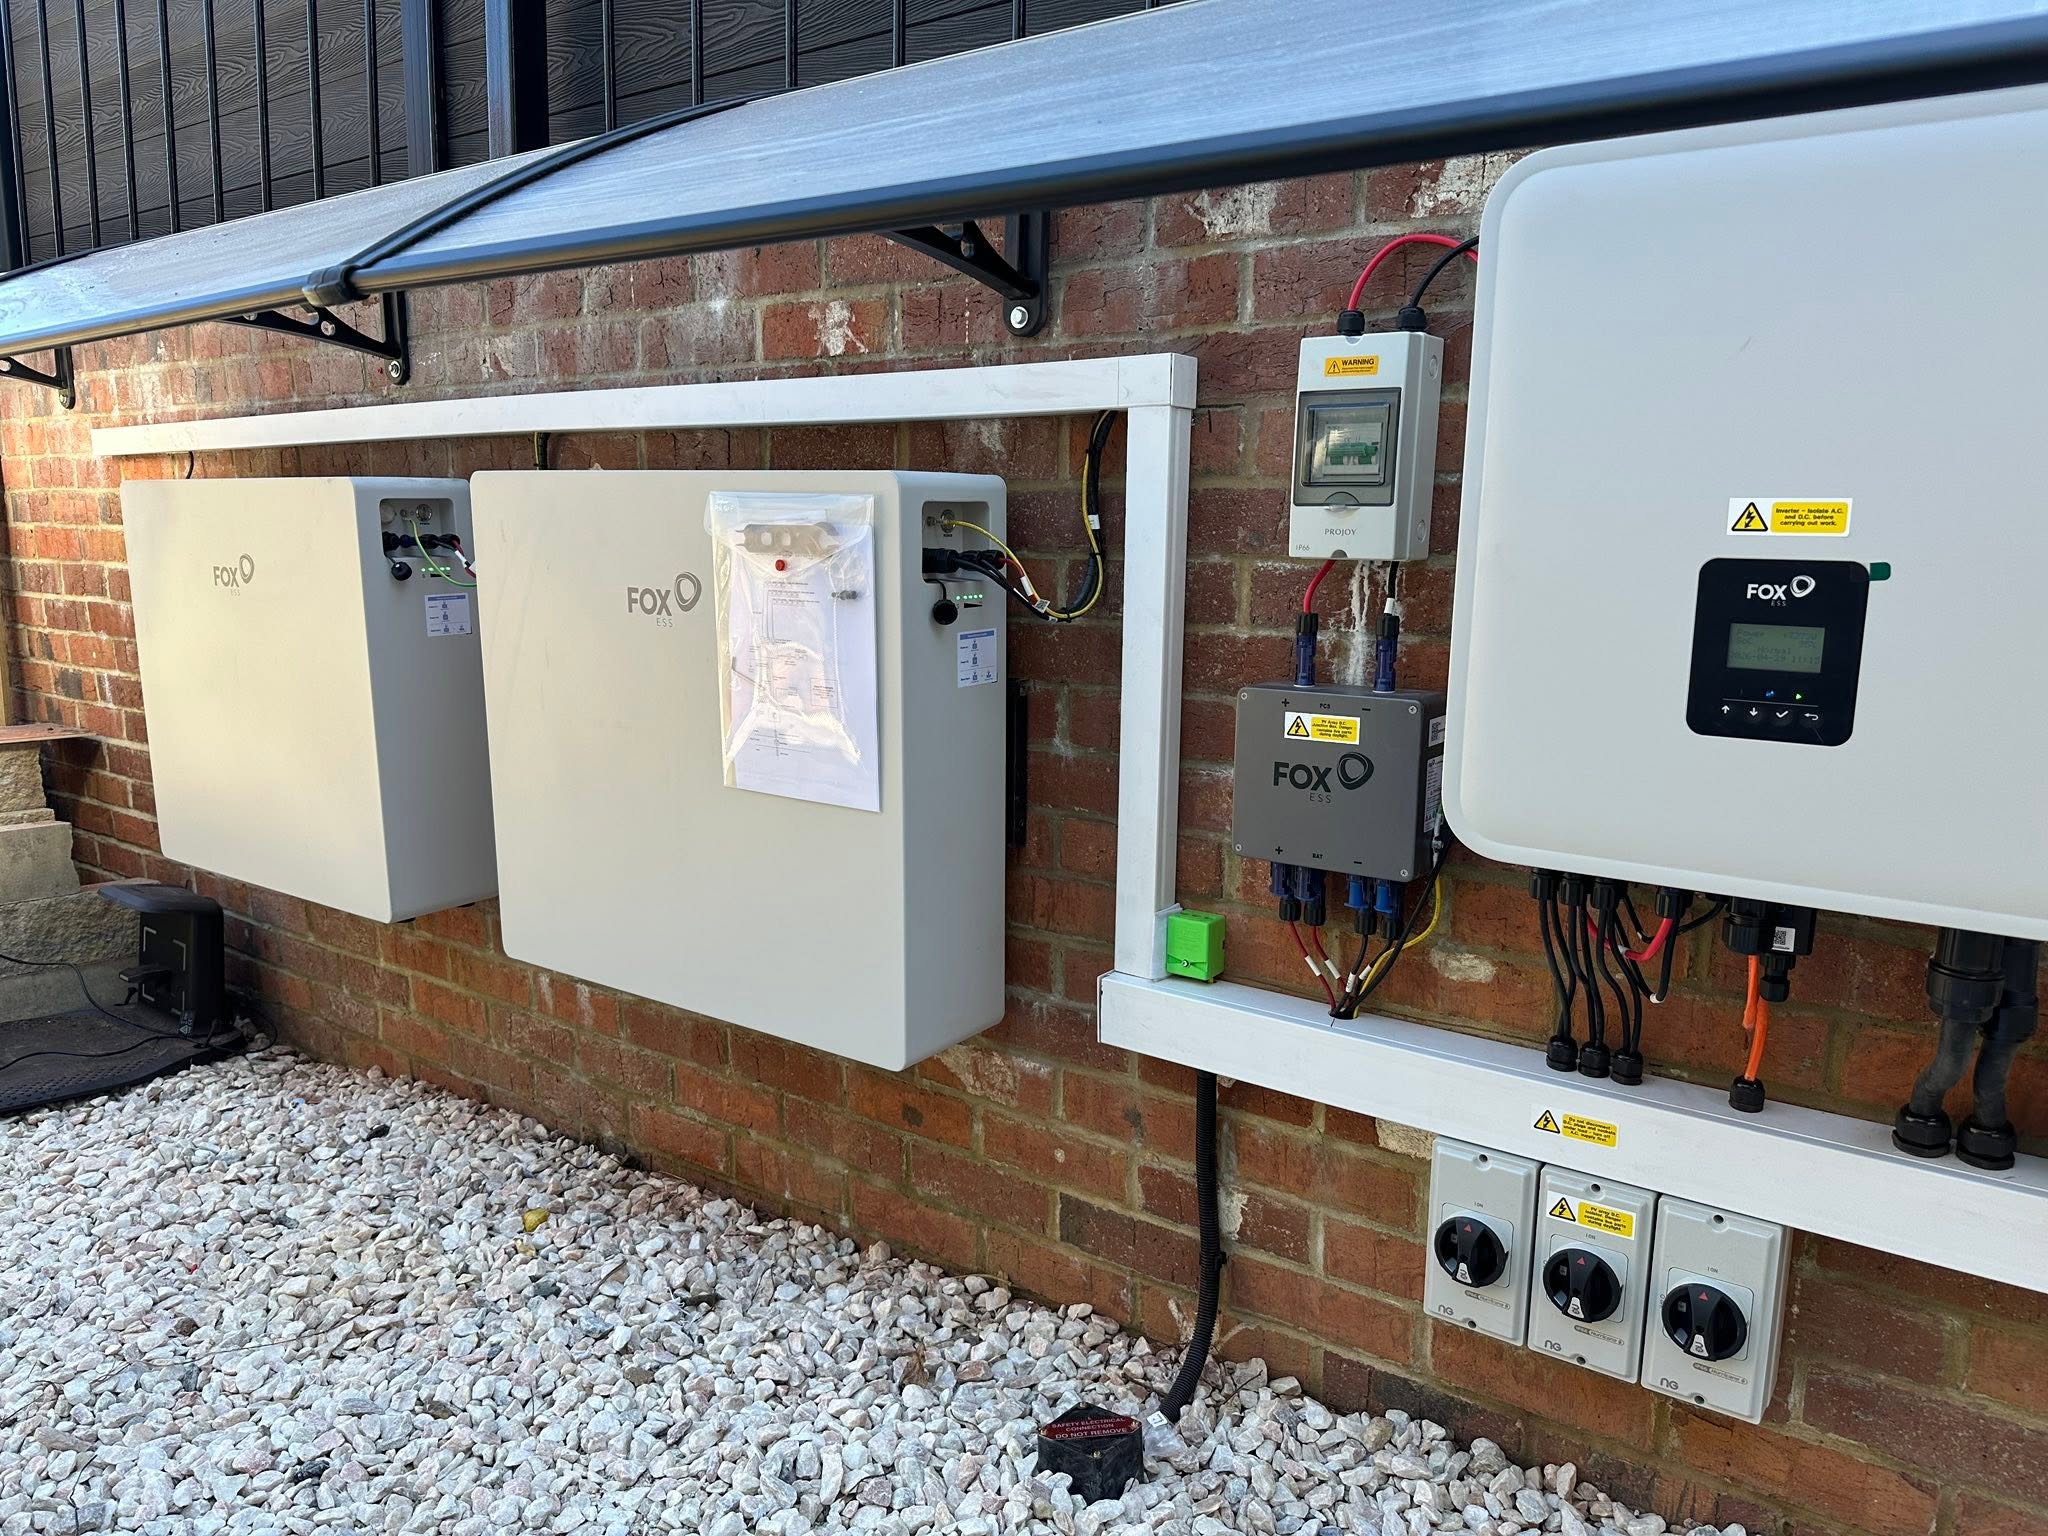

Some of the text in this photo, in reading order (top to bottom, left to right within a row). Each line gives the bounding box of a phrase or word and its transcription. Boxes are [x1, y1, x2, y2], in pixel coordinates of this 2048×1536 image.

[213, 566, 239, 587] FOX
[627, 586, 672, 616] FOX
[1746, 584, 1788, 600] FOX
[656, 618, 673, 627] ESS
[1273, 761, 1332, 792] FOX
[1310, 793, 1332, 804] ESS
